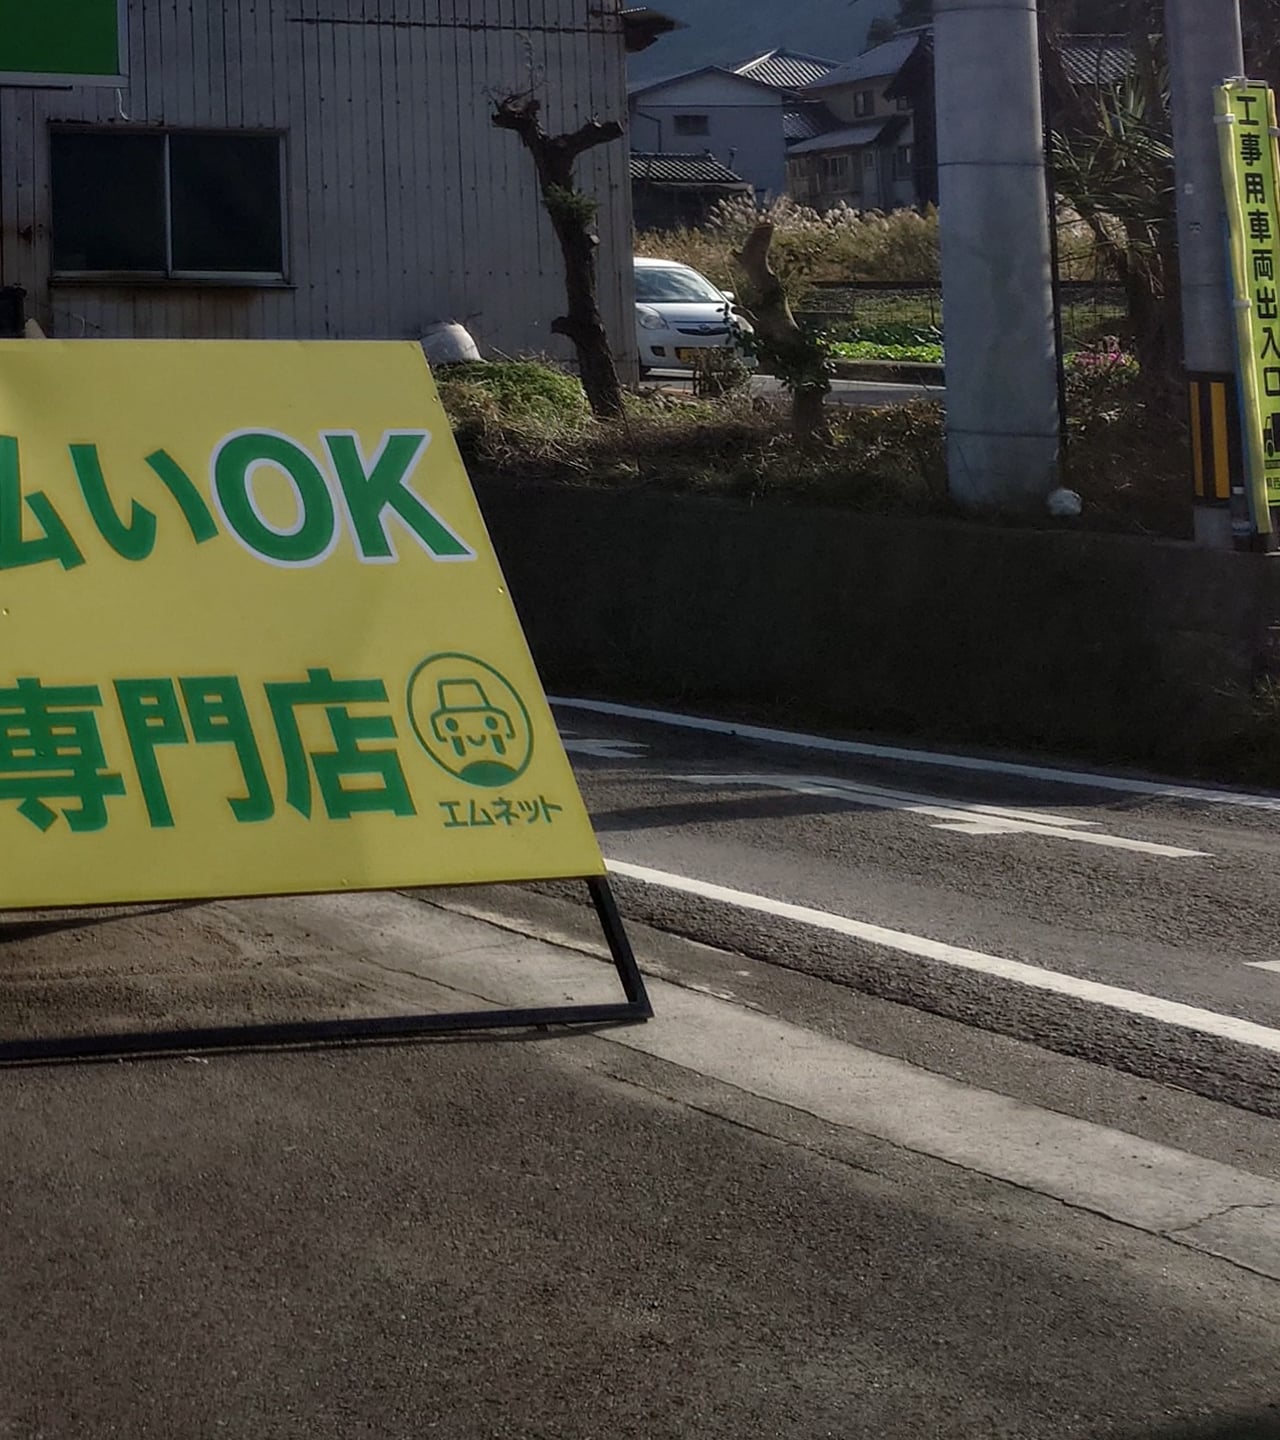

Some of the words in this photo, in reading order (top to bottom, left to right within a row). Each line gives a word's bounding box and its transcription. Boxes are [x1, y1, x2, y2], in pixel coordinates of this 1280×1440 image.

[1236, 95, 1280, 397] 工事用車両出入口
[439, 794, 563, 828] エムネット
